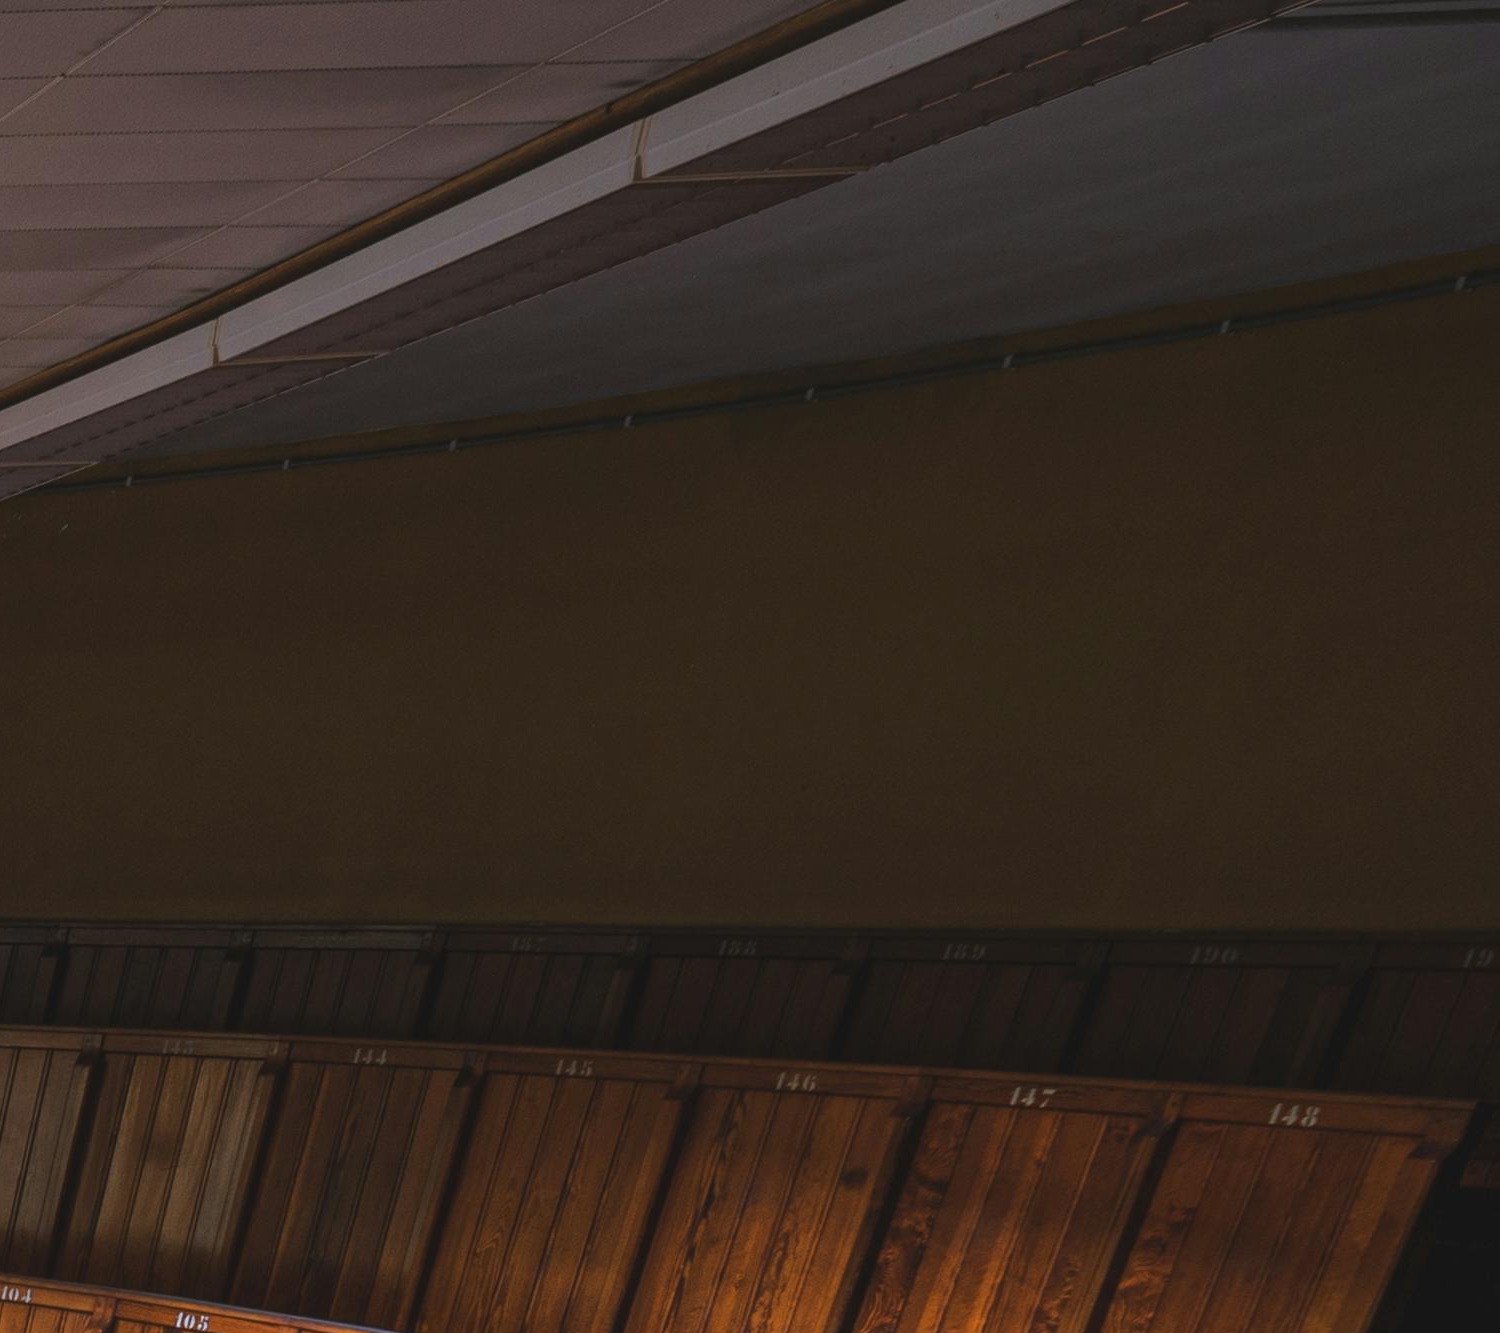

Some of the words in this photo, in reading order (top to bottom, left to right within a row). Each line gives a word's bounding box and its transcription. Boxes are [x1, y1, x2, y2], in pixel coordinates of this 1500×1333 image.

[719, 940, 756, 955] 188
[943, 944, 986, 959] 189
[1190, 947, 1239, 964] 190
[1463, 949, 1494, 967] 19
[353, 1049, 386, 1064] 144
[556, 1059, 592, 1076] 145
[776, 1073, 816, 1091] 146
[1010, 1087, 1056, 1107] 147
[1269, 1104, 1319, 1126] 148
[2, 1286, 31, 1302] 104
[176, 1312, 208, 1331] 105
